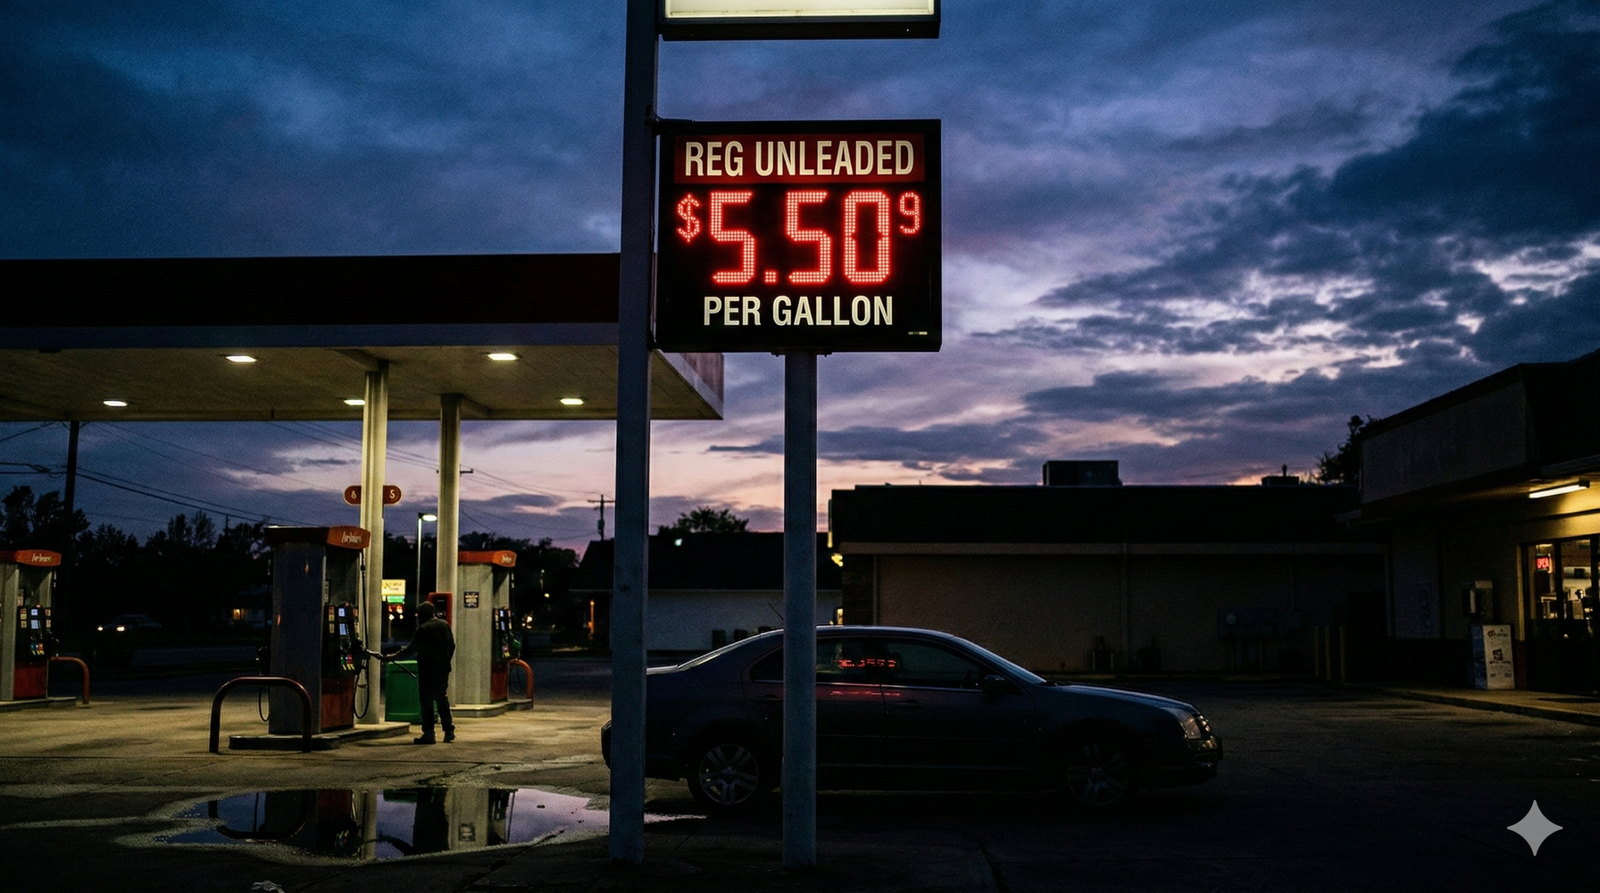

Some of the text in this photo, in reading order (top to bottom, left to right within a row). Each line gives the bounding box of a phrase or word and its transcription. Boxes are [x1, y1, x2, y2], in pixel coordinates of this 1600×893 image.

[685, 140, 915, 177] REG UNLEADED
[703, 295, 893, 327] PER GALLON
